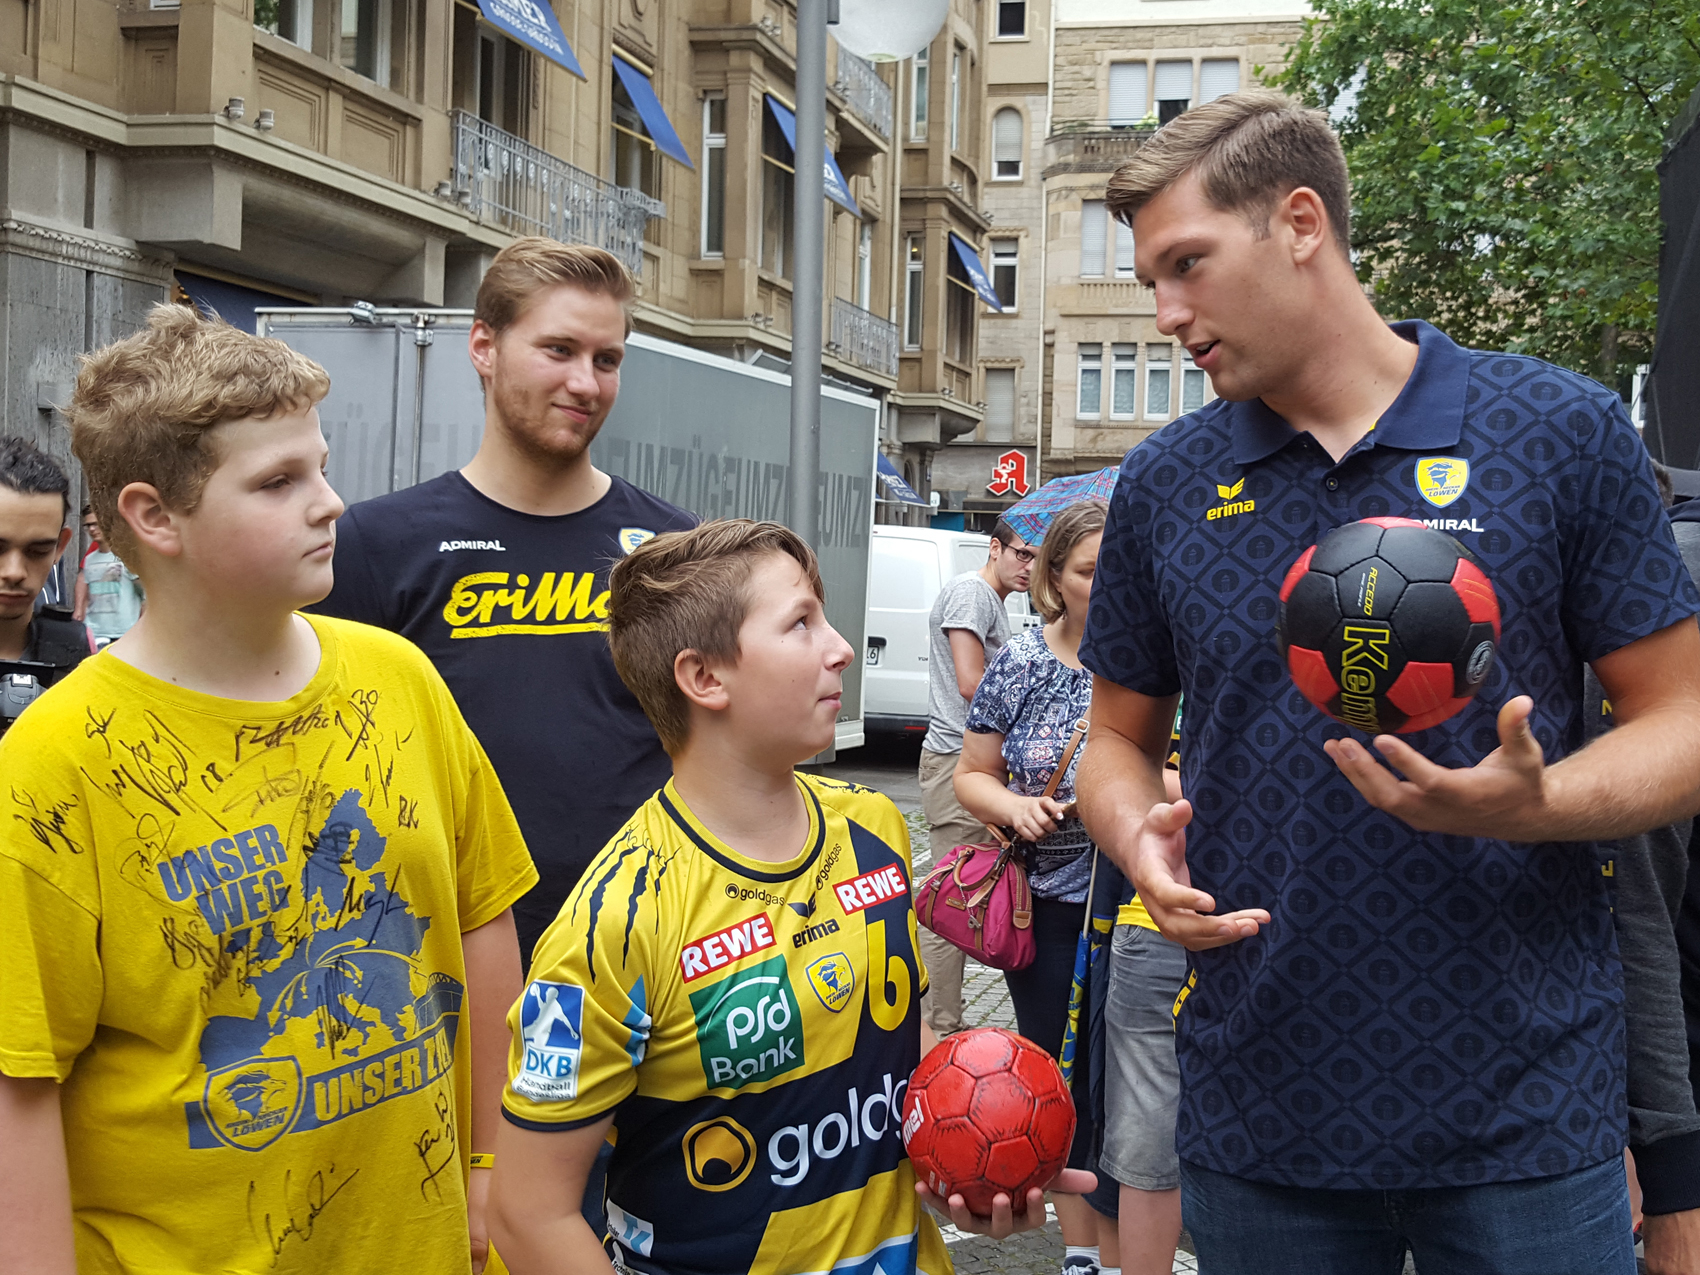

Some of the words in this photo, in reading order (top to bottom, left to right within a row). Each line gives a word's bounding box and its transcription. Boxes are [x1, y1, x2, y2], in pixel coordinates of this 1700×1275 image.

[1206, 500, 1255, 521] erima
[1412, 518, 1484, 532] MIRAL
[439, 540, 506, 552] ADMIRAL
[1364, 567, 1378, 616] ACCEDO
[157, 824, 288, 902] UNSER
[819, 843, 843, 881] goldgas
[195, 869, 290, 936] WEG
[740, 888, 785, 906] goldgas
[836, 867, 906, 912] REWE
[681, 917, 773, 978] REWE
[792, 918, 840, 948] erima
[726, 988, 792, 1050] psd
[526, 1048, 572, 1077] DKB
[710, 1036, 797, 1083] Bank
[314, 1047, 422, 1122] UNSER
